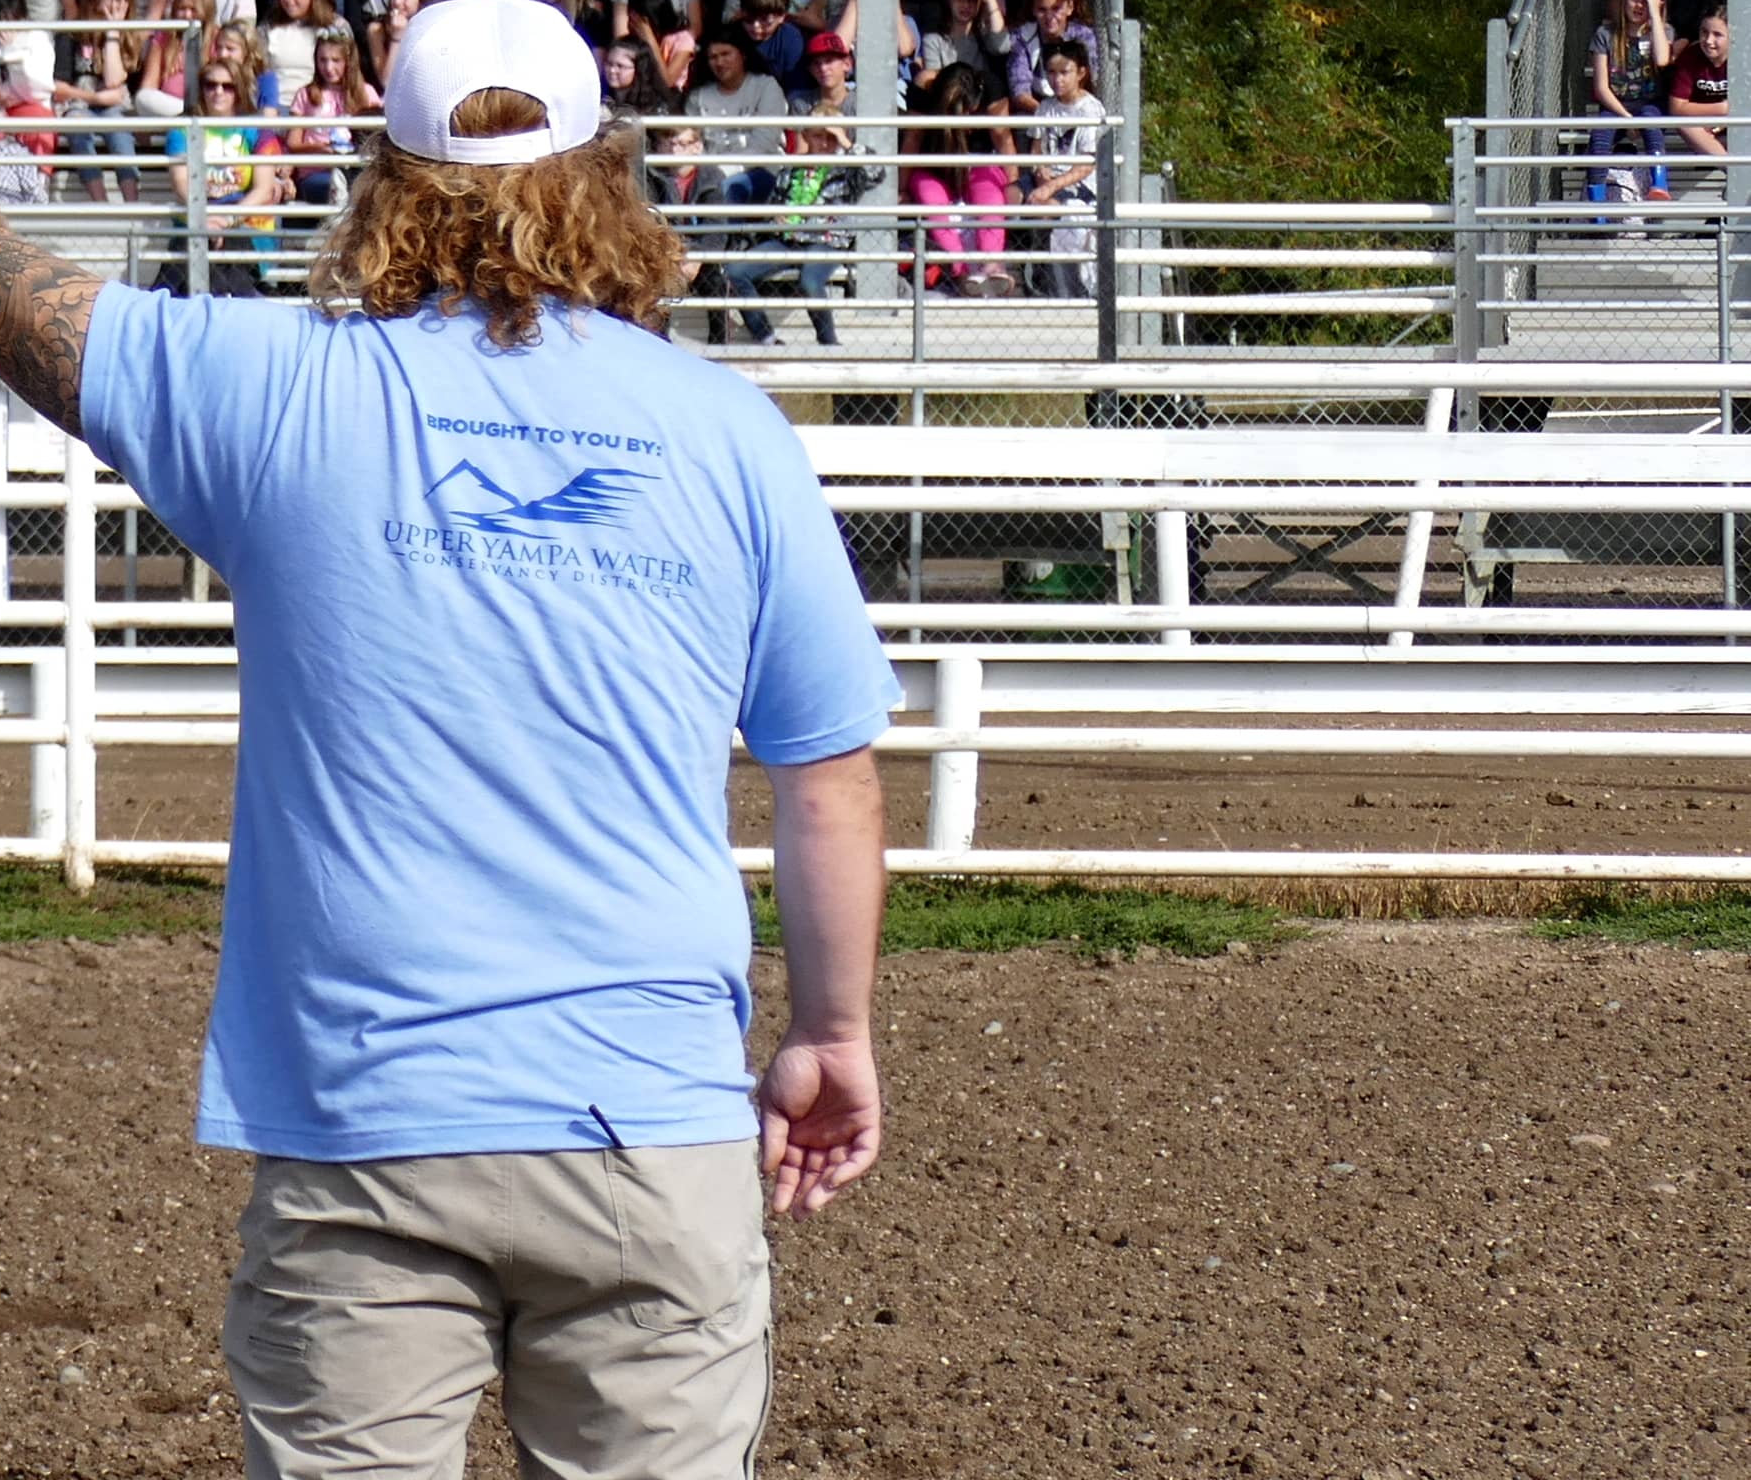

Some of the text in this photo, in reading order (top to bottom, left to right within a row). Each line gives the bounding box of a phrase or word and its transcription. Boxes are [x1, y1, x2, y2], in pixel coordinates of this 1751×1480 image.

[426, 413, 662, 457] BROUGHT TO YOU BY:
[383, 519, 694, 587] UPPER YAMPA WATER
[408, 550, 674, 599] CONSERVANCY DISTRICT
